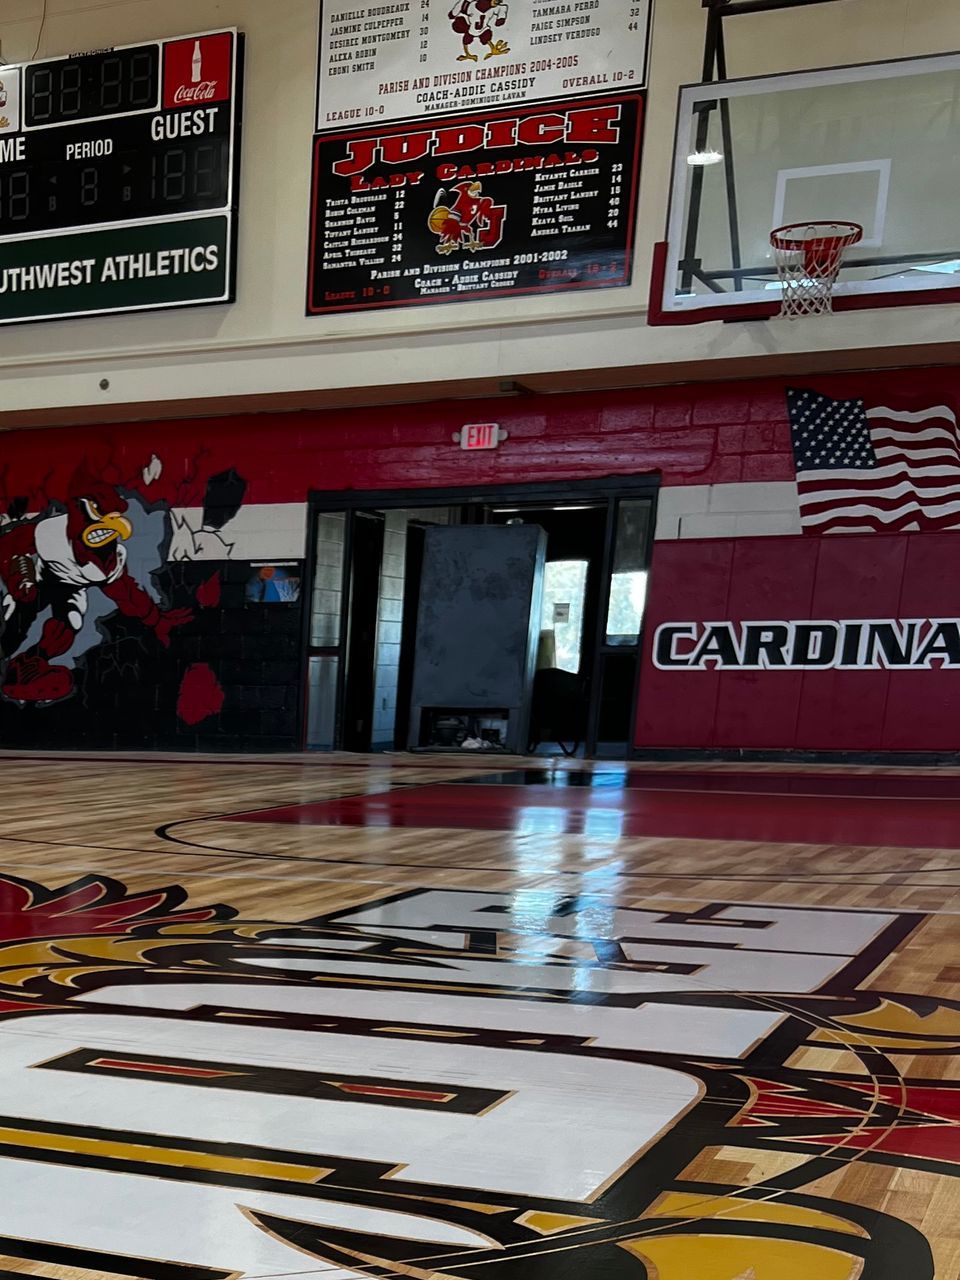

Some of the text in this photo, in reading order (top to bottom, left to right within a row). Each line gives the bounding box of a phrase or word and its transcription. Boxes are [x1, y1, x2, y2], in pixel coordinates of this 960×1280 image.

[330, 9, 365, 23] DANIELLE
[367, 3, 410, 17] BOUDREAUX
[530, 7, 640, 32] PAIGE SIMPSON 32
[532, 4, 572, 18] TAMMARA
[330, 13, 429, 36] JASMINE CULPEPPER 14
[530, 22, 638, 46] LINDSEY VERDUGO 44
[329, 27, 429, 50] DESIREE MONTGOMERY 30
[329, 40, 428, 63] ALEXA ROBIN 12
[328, 54, 427, 76] EBONI SMITH 10
[378, 55, 579, 95] PARISH AND DIVISION CHAMPIONS 2004-2005
[562, 70, 635, 89] OVERALL 10-2
[416, 77, 536, 103] COACH-ADDIE CASSIDY
[424, 91, 526, 111] MANAGER-DOMINIQUE LAVAN
[326, 105, 385, 121] LEAGUE 10-0
[151, 107, 219, 141] GUEST
[66, 138, 113, 161] PERIOD
[332, 104, 622, 177] JUDICE
[350, 149, 600, 193] LADY CARDINALS
[611, 163, 623, 172] 23
[534, 183, 556, 193] JAMIE
[611, 174, 622, 184] 14
[325, 198, 349, 207] TRISTA
[395, 190, 406, 199] 12
[533, 194, 568, 204] BRITTANY
[570, 190, 599, 199] LANDRY
[346, 206, 376, 215] COLEMAN
[394, 201, 405, 209] 22
[532, 205, 554, 215] MYRA
[607, 208, 619, 217] 20
[324, 212, 400, 228] SHANNON DAVIS 5
[530, 228, 559, 238] ANDREA
[606, 219, 618, 228] 44
[324, 222, 403, 239] TIFFANY LANDRY 11
[323, 240, 349, 249] CAITLIN
[392, 233, 403, 242] 34
[323, 251, 343, 260] APRIL
[391, 243, 403, 252] 32
[100, 244, 219, 282] ATHLETICS
[322, 260, 357, 270] SAMANTHA
[391, 254, 402, 263] 24
[370, 250, 568, 280] PARISH AND DIVISION CHAMPIONS 2001-2002
[414, 278, 442, 288] COACH
[451, 274, 479, 285] ADDIE
[481, 270, 519, 281] CASSIDY
[324, 291, 356, 301] LEAGUE
[419, 286, 450, 295] MANAGER
[467, 424, 496, 448] EXIT
[652, 616, 960, 672] CARDINA
